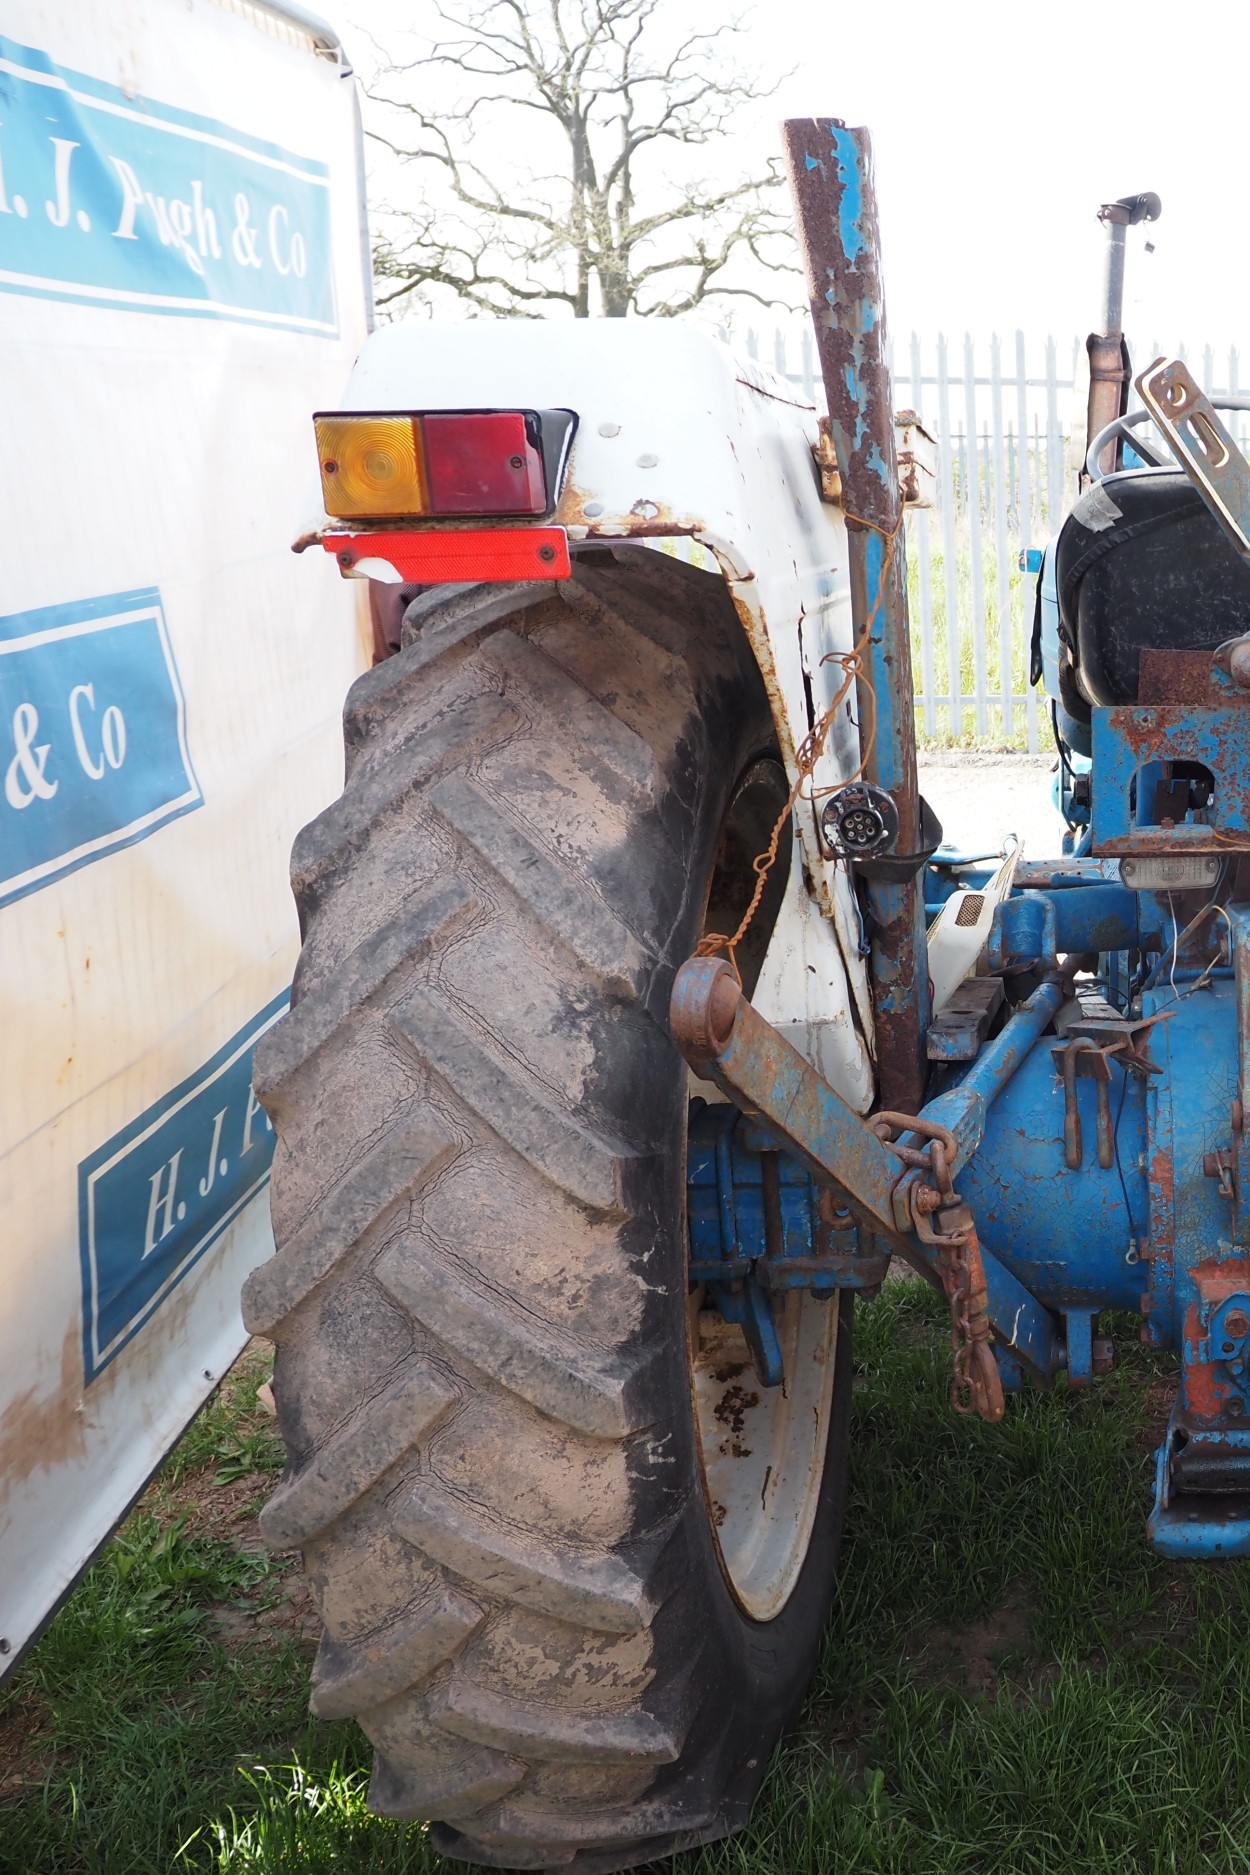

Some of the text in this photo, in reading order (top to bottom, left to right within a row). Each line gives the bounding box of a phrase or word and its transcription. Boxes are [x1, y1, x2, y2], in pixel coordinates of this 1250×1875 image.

[46, 136, 91, 232] J.
[107, 155, 221, 275] Pugh
[231, 192, 262, 269] &
[268, 204, 306, 278] Co
[5, 682, 126, 810] & Co
[141, 1147, 186, 1261] H.
[199, 1106, 228, 1197] J.
